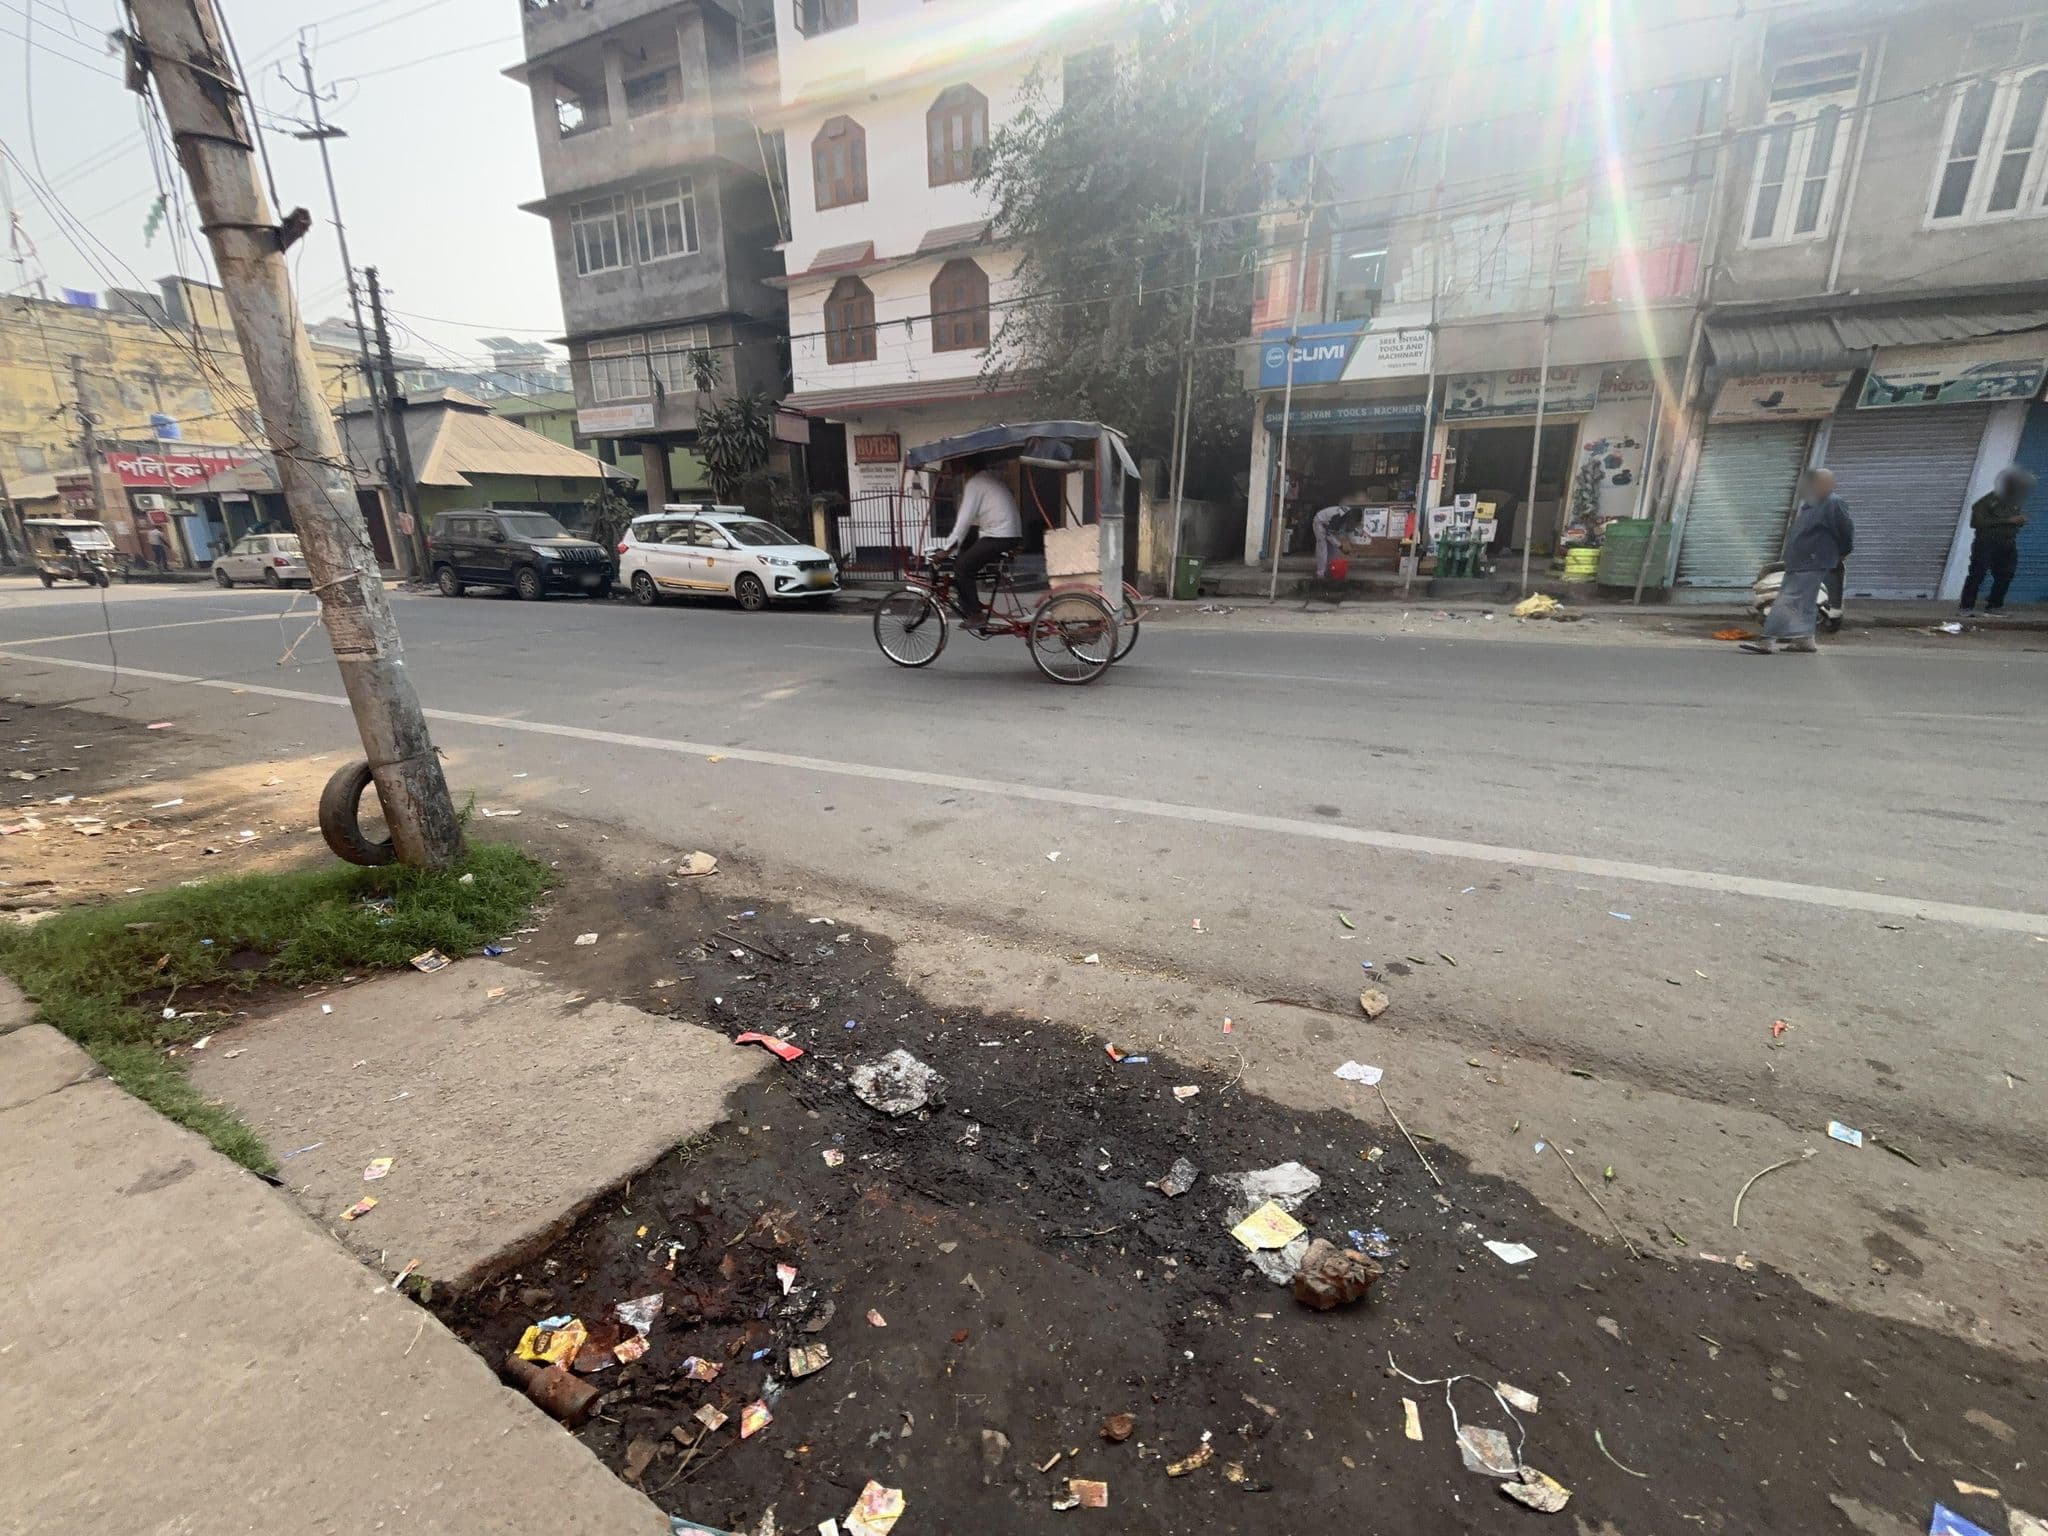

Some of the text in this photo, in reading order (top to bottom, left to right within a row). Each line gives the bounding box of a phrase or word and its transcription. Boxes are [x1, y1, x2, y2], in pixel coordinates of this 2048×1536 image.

[1287, 344, 1345, 362] CUMI
[1380, 343, 1424, 353] TOOLS AND
[1337, 408, 1367, 418] TOOLS
[856, 437, 896, 456] HOTEL
